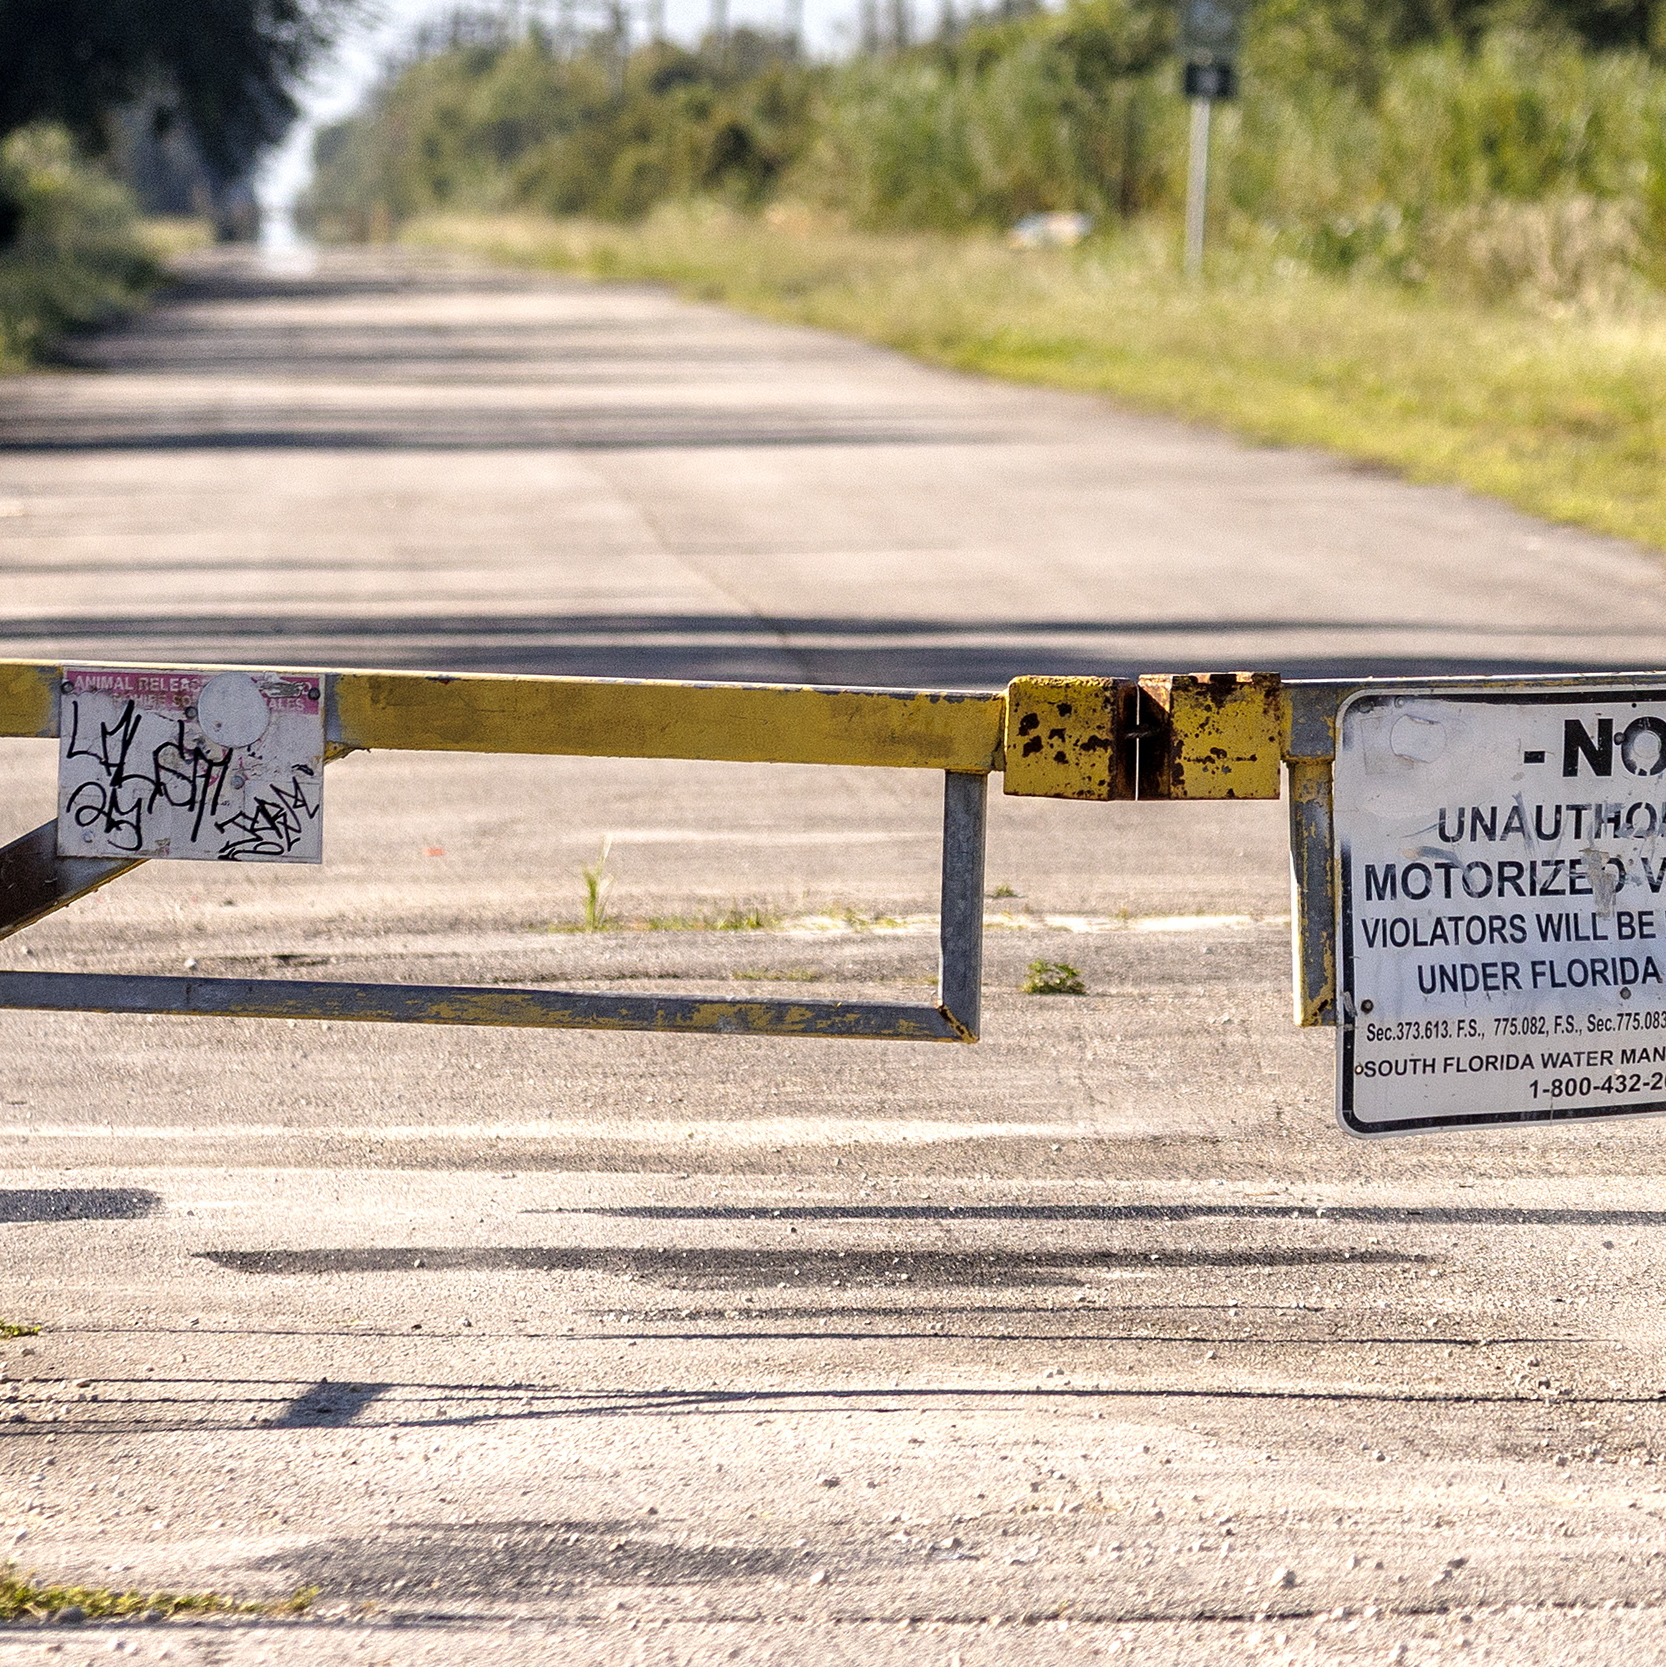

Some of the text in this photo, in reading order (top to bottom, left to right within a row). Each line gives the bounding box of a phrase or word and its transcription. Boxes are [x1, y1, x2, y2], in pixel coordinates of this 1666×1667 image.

[74, 675, 134, 691] ANIMAL
[1361, 913, 1528, 948] VIOLATORS
[1535, 911, 1608, 944] WILL
[1617, 910, 1656, 941] BE
[1418, 961, 1523, 994] UNDER
[1532, 955, 1663, 989] FLORIDA
[1494, 1015, 1549, 1038] 775.082,
[1554, 1014, 1582, 1036] F.S.,
[1364, 1058, 1436, 1077] SOUTH
[1443, 1054, 1535, 1074] FLORIDA
[1541, 1050, 1614, 1069] WATER
